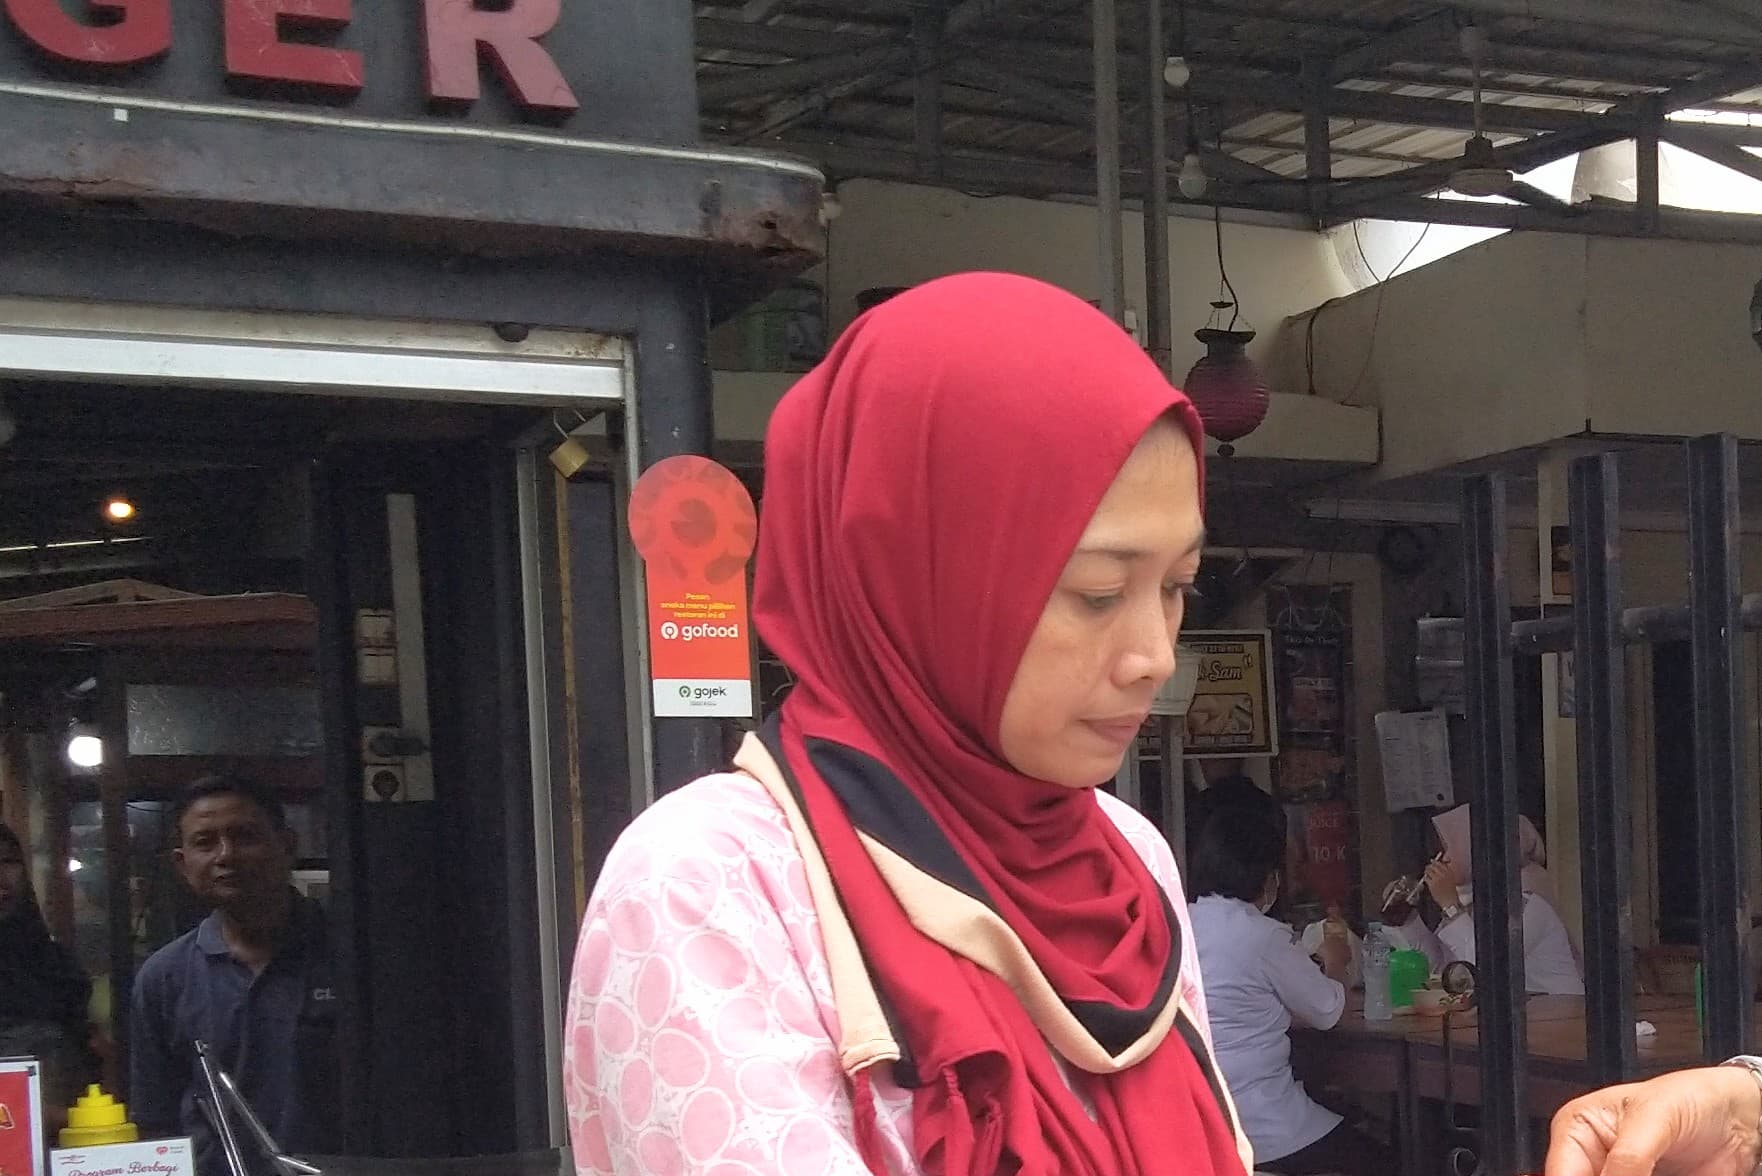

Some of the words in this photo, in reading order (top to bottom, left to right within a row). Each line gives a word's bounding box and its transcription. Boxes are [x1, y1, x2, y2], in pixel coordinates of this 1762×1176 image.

[681, 623, 739, 641] gofood
[694, 686, 727, 698] gojek
[127, 1161, 179, 1176] Berbagi
